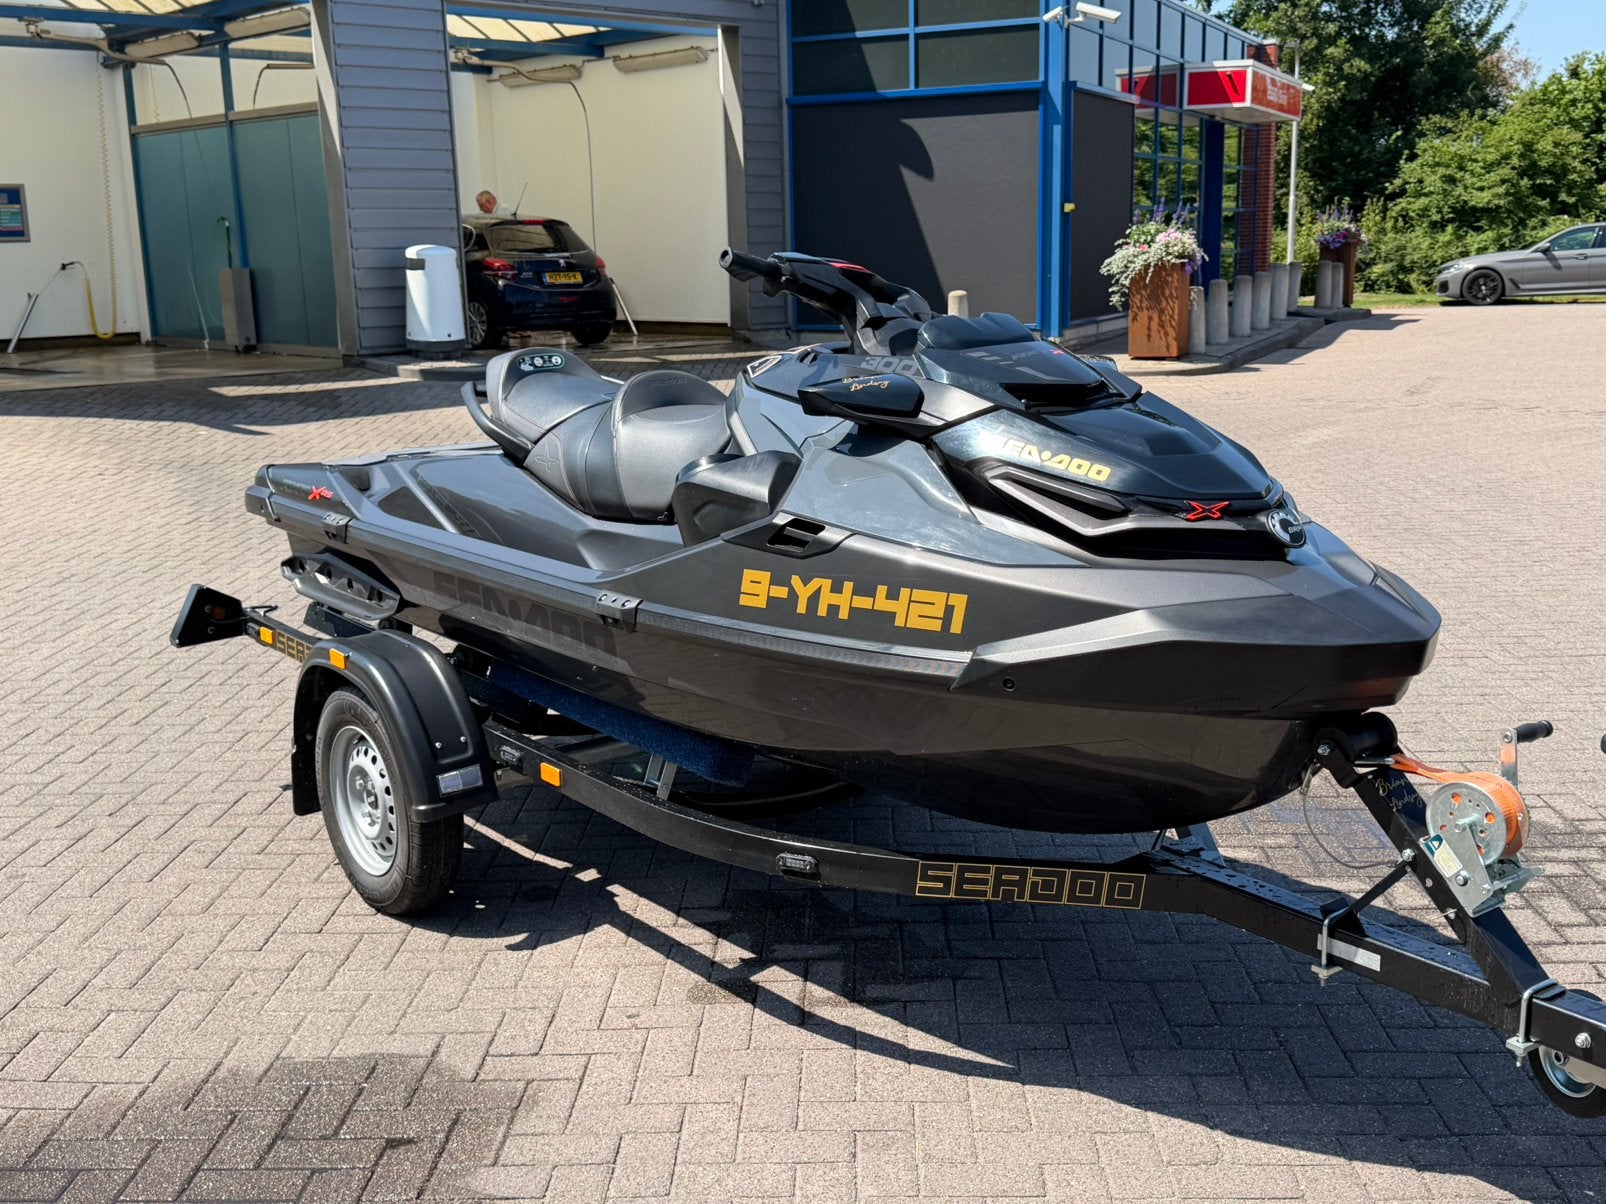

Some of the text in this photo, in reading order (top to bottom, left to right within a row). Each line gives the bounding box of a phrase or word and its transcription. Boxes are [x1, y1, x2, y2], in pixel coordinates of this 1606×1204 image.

[860, 357, 919, 375] 300
[739, 568, 968, 634] 9-YH-421
[915, 860, 1147, 910] SEADOO
